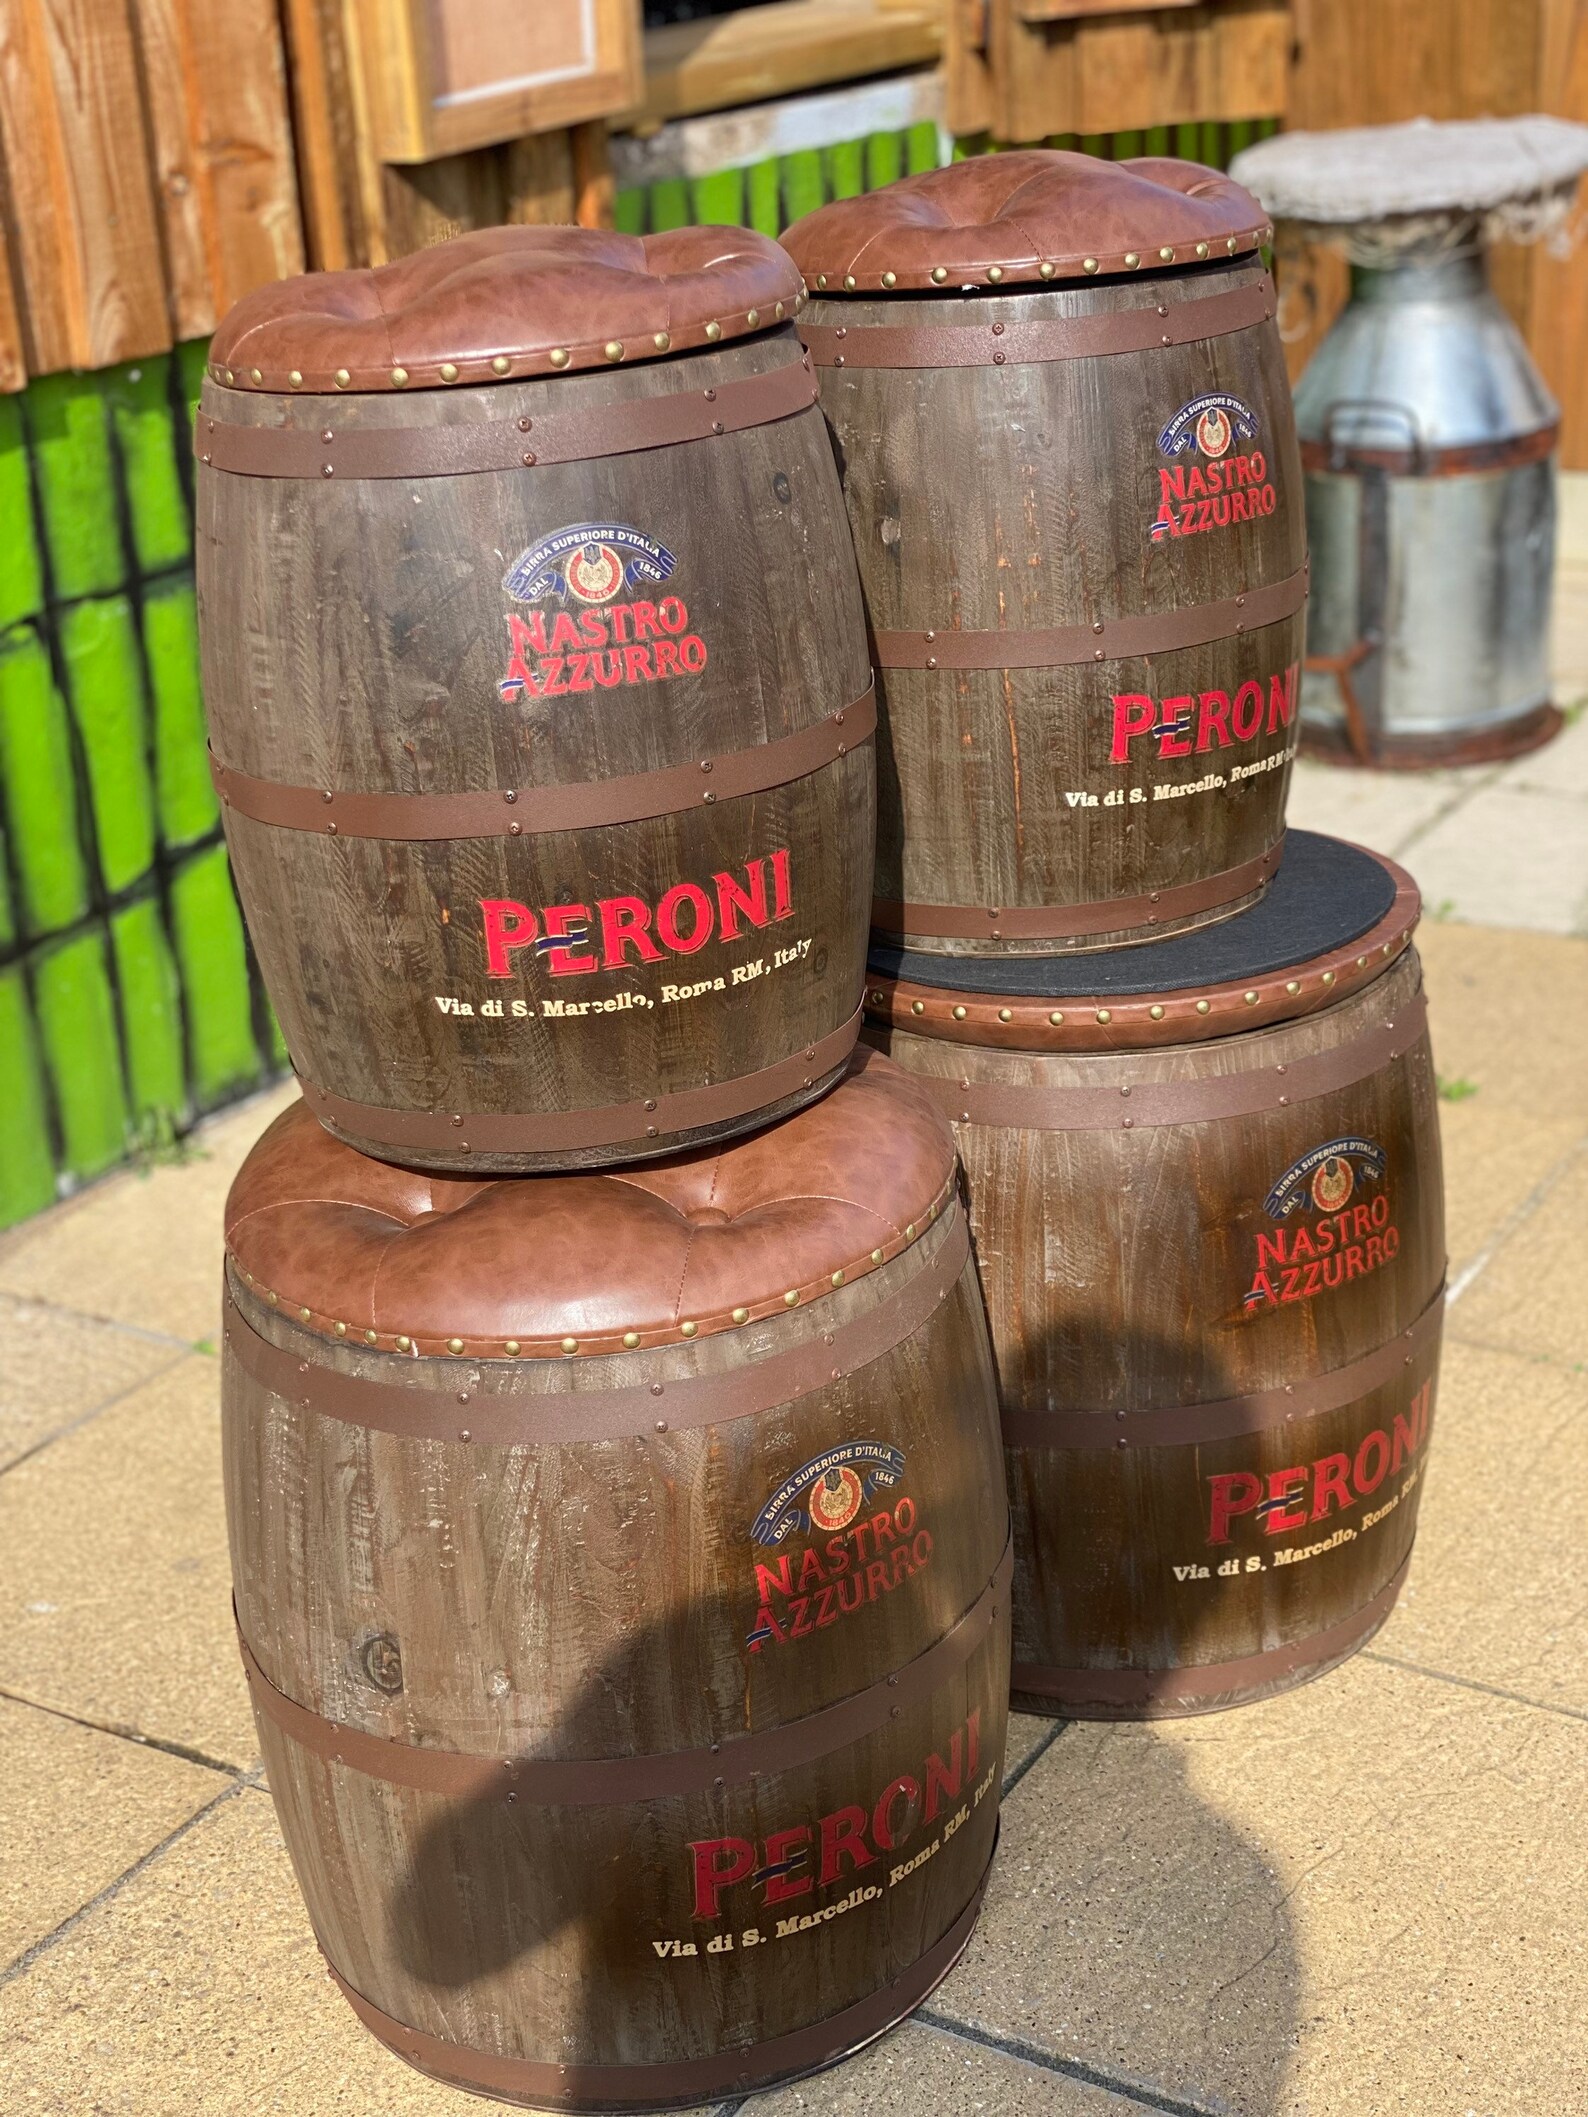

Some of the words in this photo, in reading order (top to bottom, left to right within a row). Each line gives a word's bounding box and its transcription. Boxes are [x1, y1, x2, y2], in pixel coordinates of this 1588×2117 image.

[1188, 398, 1226, 415] SUPERIORE
[1226, 399, 1251, 420] D'ITALA
[1173, 437, 1187, 452] DAL
[1159, 451, 1267, 503] NASTRO
[1151, 484, 1277, 541] AZZURRO
[520, 548, 553, 577] BIRRA
[552, 530, 615, 552] SUPERIORE
[617, 531, 661, 557] D'ITALA
[639, 561, 662, 580] 1846
[529, 577, 549, 597] DAL
[504, 596, 688, 656] NASTRO
[500, 635, 708, 703] AZZURRO
[1109, 662, 1299, 765] PERONI
[1066, 792, 1099, 808] Via
[1104, 789, 1125, 806] di
[1129, 788, 1147, 804] S.
[1153, 774, 1227, 802] Marcello,
[1230, 760, 1267, 782] Roma
[478, 848, 795, 979] PERONI
[435, 996, 474, 1017] Via
[481, 997, 504, 1018] di
[512, 1001, 535, 1018] S.
[543, 993, 654, 1018] Marcello,
[661, 976, 726, 1003] Roma
[731, 957, 771, 987] RM,
[775, 938, 813, 969] Italy
[1301, 1142, 1348, 1171] SUPERIORE
[1349, 1142, 1378, 1158] D'ITALA
[1254, 1195, 1389, 1270] NASTRO
[1282, 1196, 1299, 1215] DAL
[1244, 1226, 1399, 1311] AZZURRO
[794, 1449, 853, 1487] SUPERIORE
[855, 1446, 892, 1462] D'ITALA
[875, 1471, 894, 1485] 1846
[1204, 1377, 1431, 1547] PERONI
[754, 1497, 916, 1606] NASTRO
[774, 1517, 794, 1540] DAL
[1172, 1564, 1210, 1581] Via
[1218, 1559, 1240, 1577] di
[1245, 1556, 1267, 1572] S.
[1273, 1529, 1358, 1567] Marcello,
[1361, 1495, 1399, 1531] Roma
[746, 1529, 934, 1653] AZZURRO
[685, 1706, 981, 1923] PERONI
[653, 1941, 698, 1958] Via
[706, 1935, 734, 1954] di
[742, 1929, 767, 1947] S.
[775, 1885, 883, 1938] Marcello,
[889, 1839, 940, 1887] Roma
[943, 1803, 971, 1843] RM,
